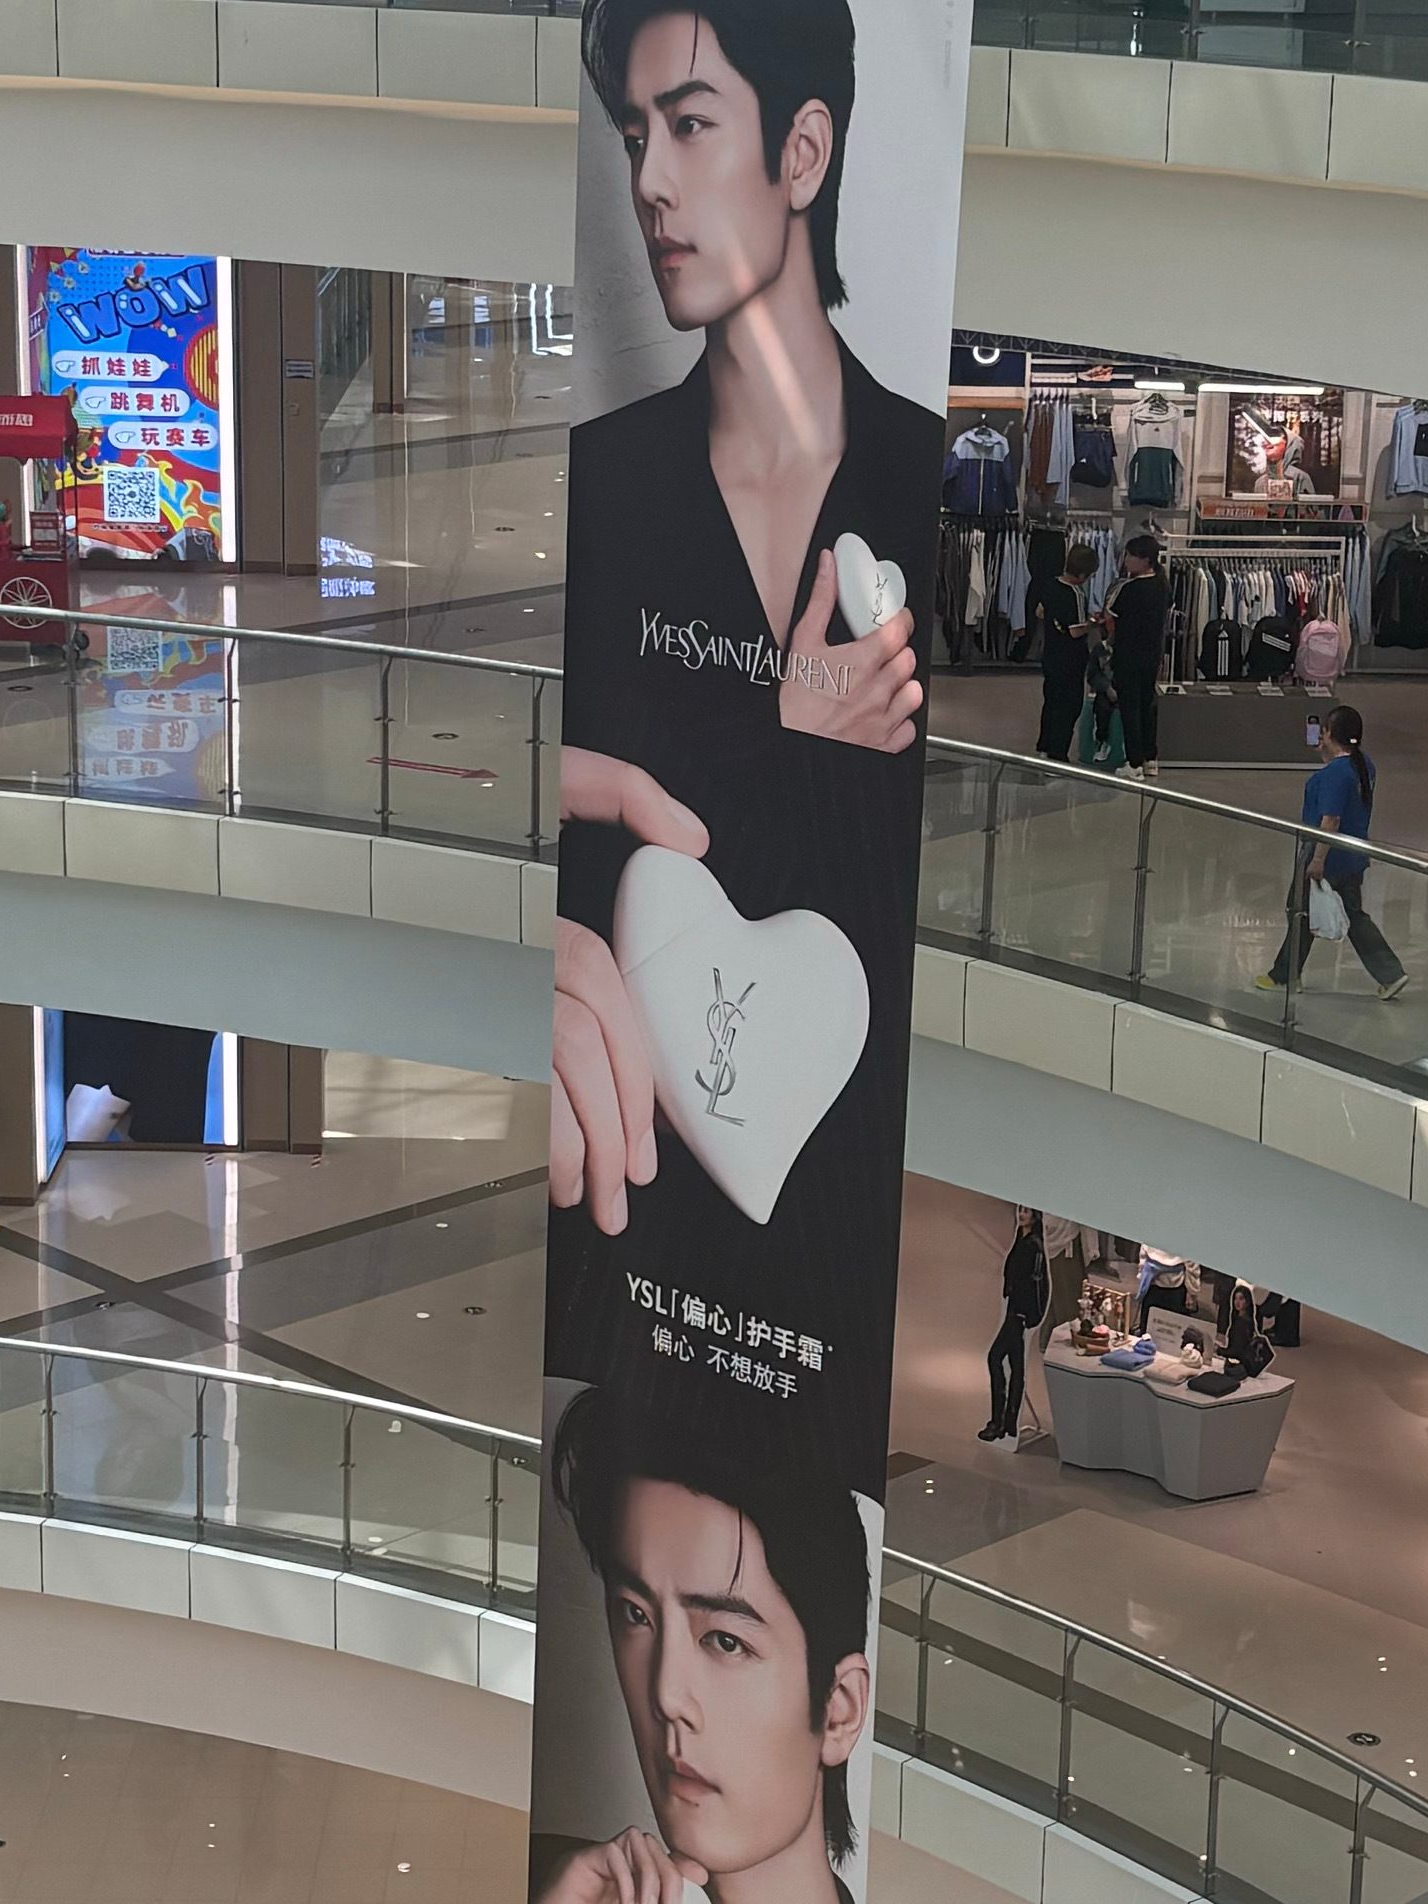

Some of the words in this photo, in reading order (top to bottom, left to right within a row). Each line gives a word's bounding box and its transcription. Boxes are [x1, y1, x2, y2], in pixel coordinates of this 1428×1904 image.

[57, 264, 211, 344] WOW
[110, 392, 180, 412] 跳舞机
[140, 427, 211, 447] 玩赛车
[651, 1323, 695, 1363] 偏心
[707, 1343, 799, 1400] 不想放手
